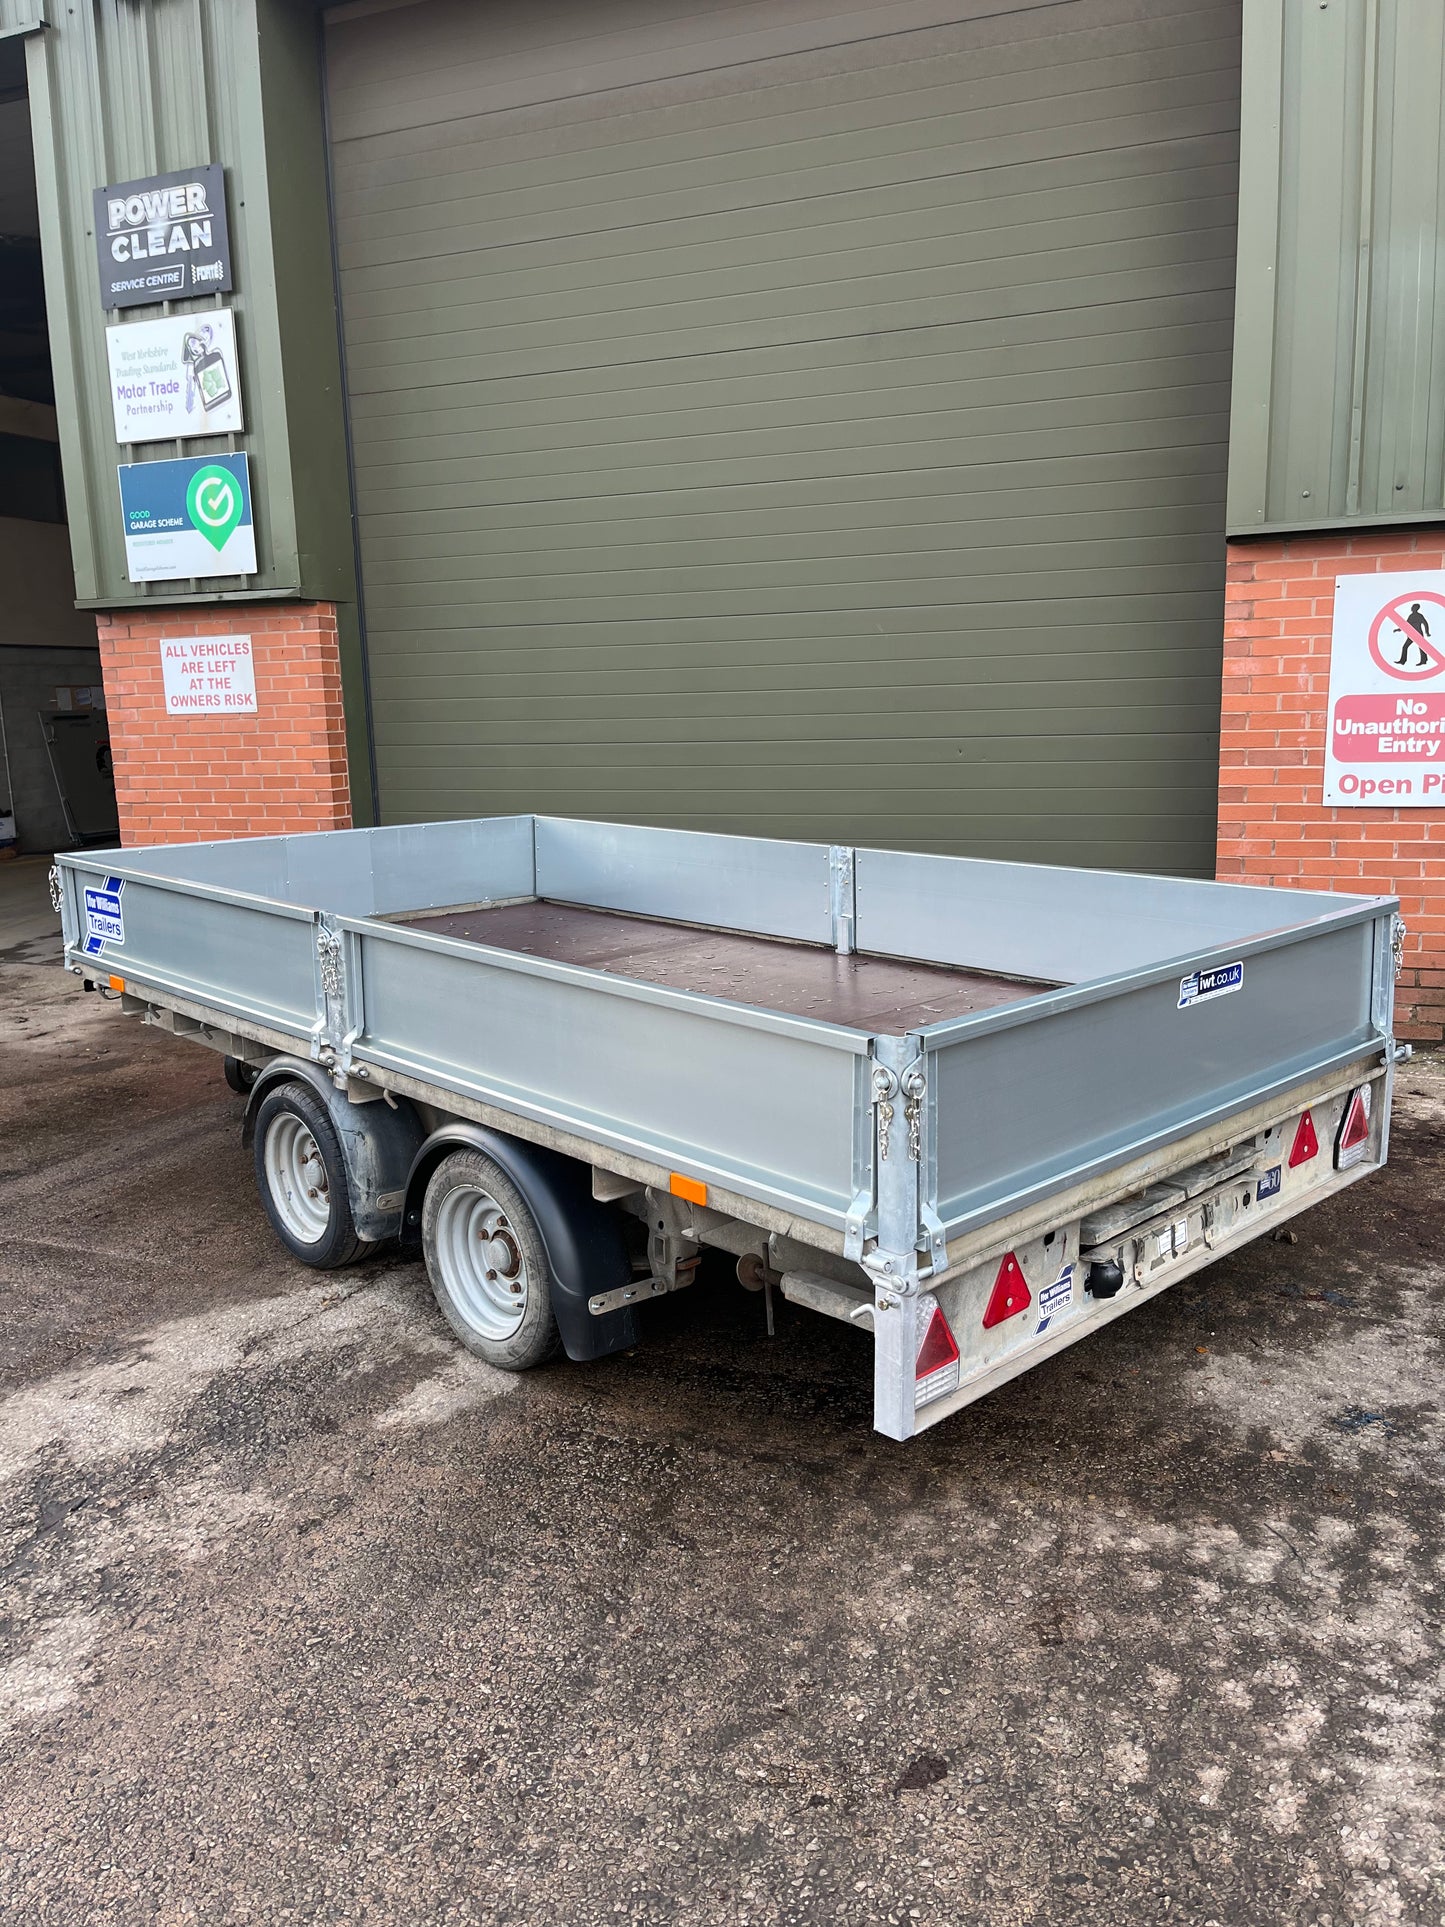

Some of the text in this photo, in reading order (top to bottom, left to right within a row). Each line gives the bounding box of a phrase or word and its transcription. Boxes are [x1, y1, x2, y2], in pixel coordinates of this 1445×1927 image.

[107, 183, 209, 229] POWER
[111, 220, 213, 263] CLEAN
[110, 271, 180, 293] SERVICE CENTRE
[136, 346, 169, 360] Yorkshire
[142, 360, 178, 375] Standards
[116, 379, 180, 400] Motor Trade
[126, 400, 174, 416] Partnership
[129, 510, 150, 520] GOOD
[130, 517, 184, 530] GARAGE SCHEME
[166, 642, 250, 658] ALL VEHICLES
[181, 660, 236, 674] ARE LEFT
[189, 677, 232, 690] AT THE
[170, 693, 253, 707] OWNERS RISK
[1395, 698, 1427, 716] No
[1378, 737, 1440, 756] Entry
[1338, 773, 1412, 799] Open
[89, 914, 121, 936] Trailers
[1199, 967, 1240, 991] iwt.co.uk
[1041, 1293, 1071, 1315] Trailers
